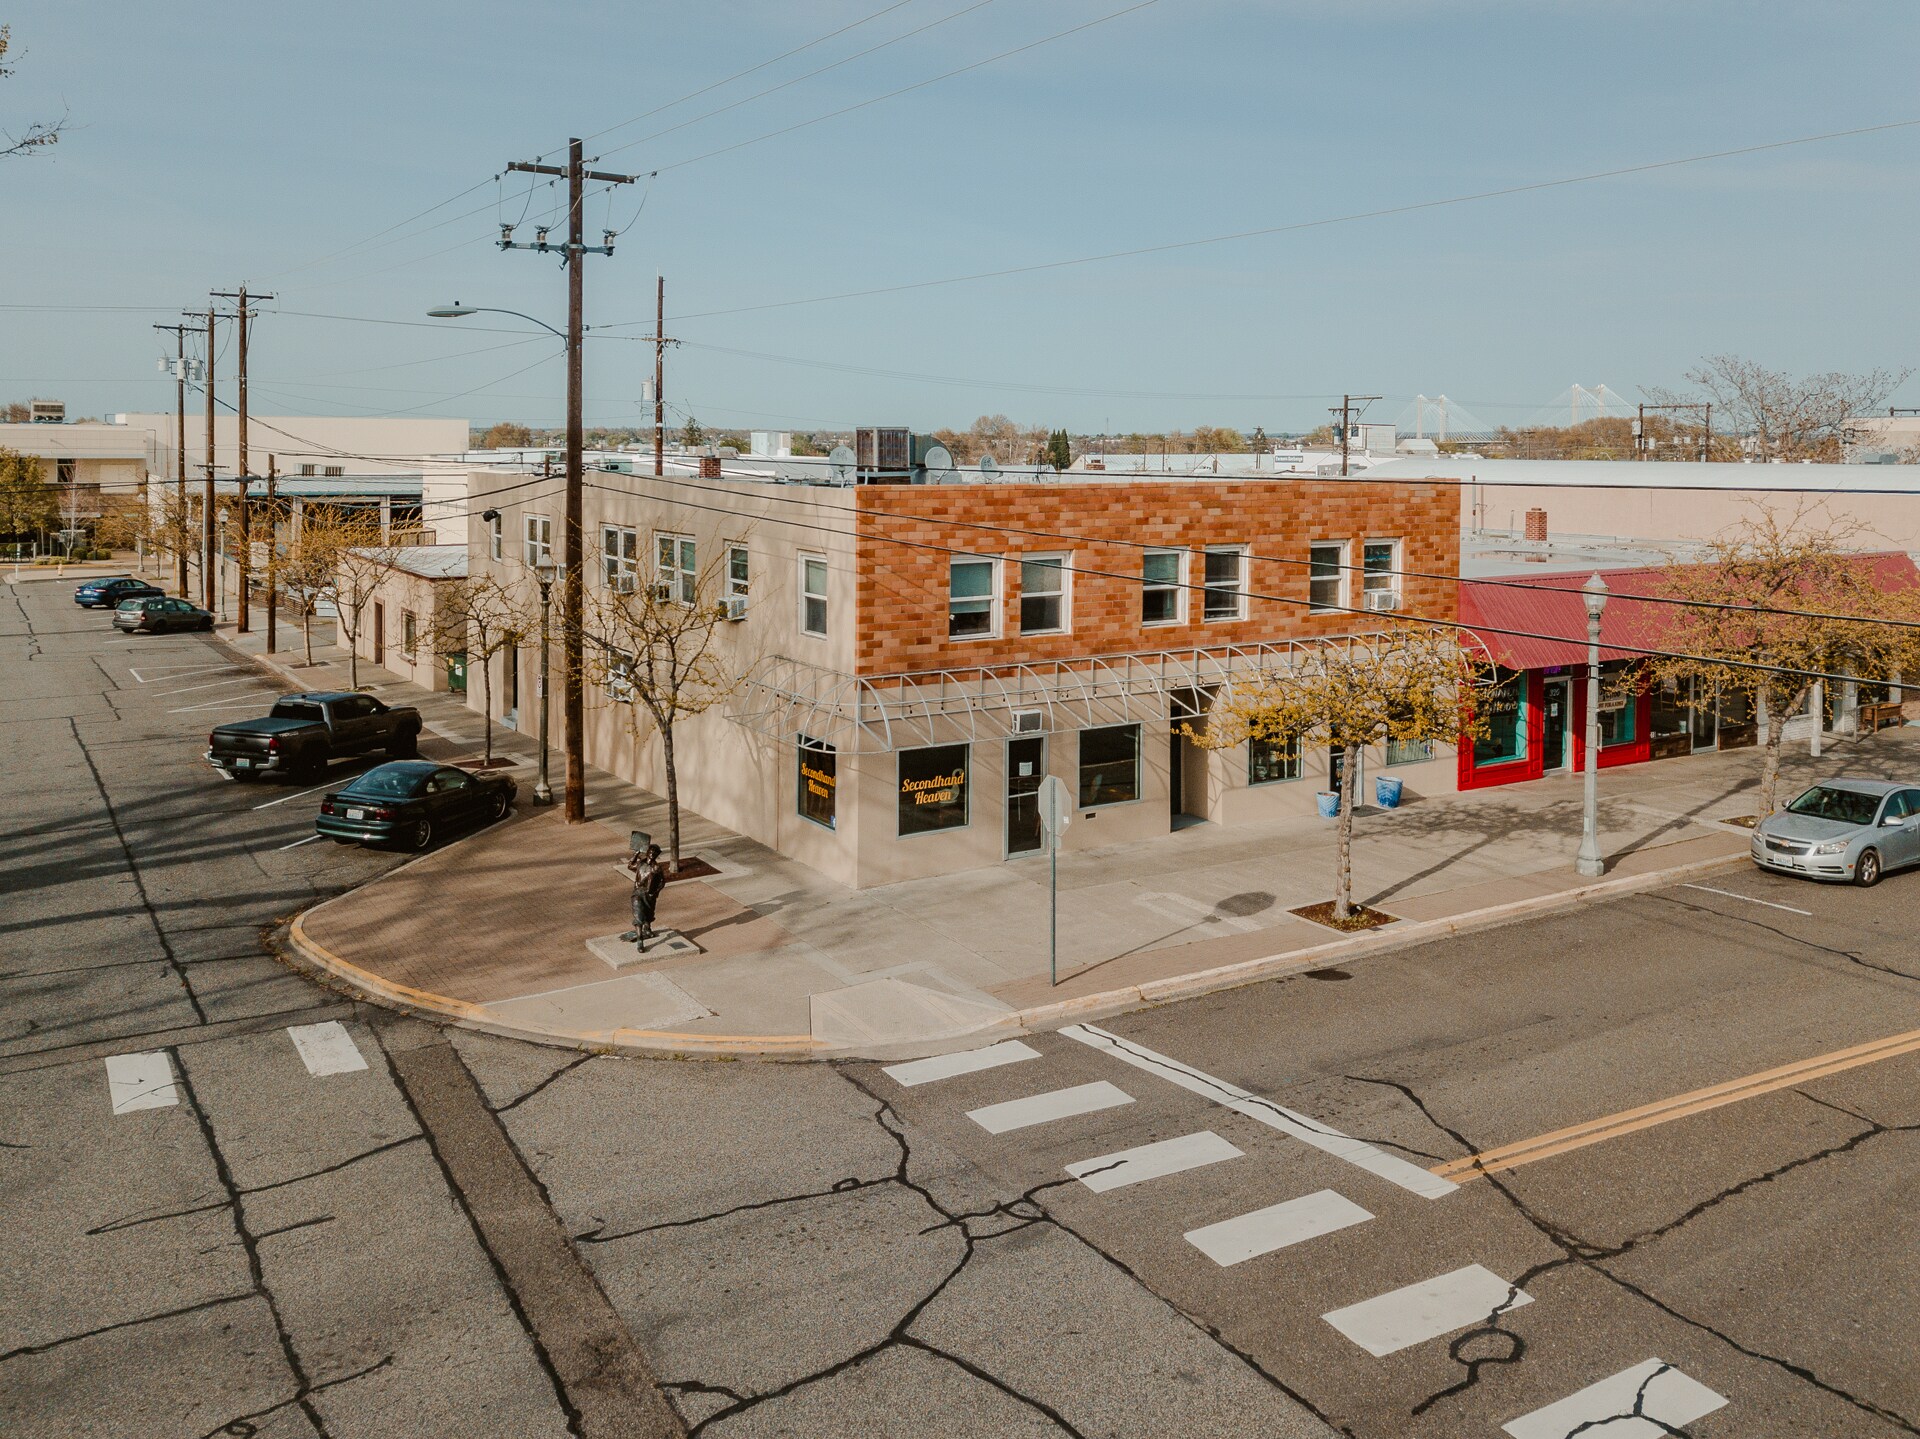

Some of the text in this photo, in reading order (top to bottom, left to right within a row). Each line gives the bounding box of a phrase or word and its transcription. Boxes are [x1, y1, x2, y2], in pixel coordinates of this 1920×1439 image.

[801, 762, 836, 788] Secondhand
[901, 771, 965, 792] Secondhand
[807, 779, 829, 799] Heaven
[914, 791, 952, 805] Heaven
